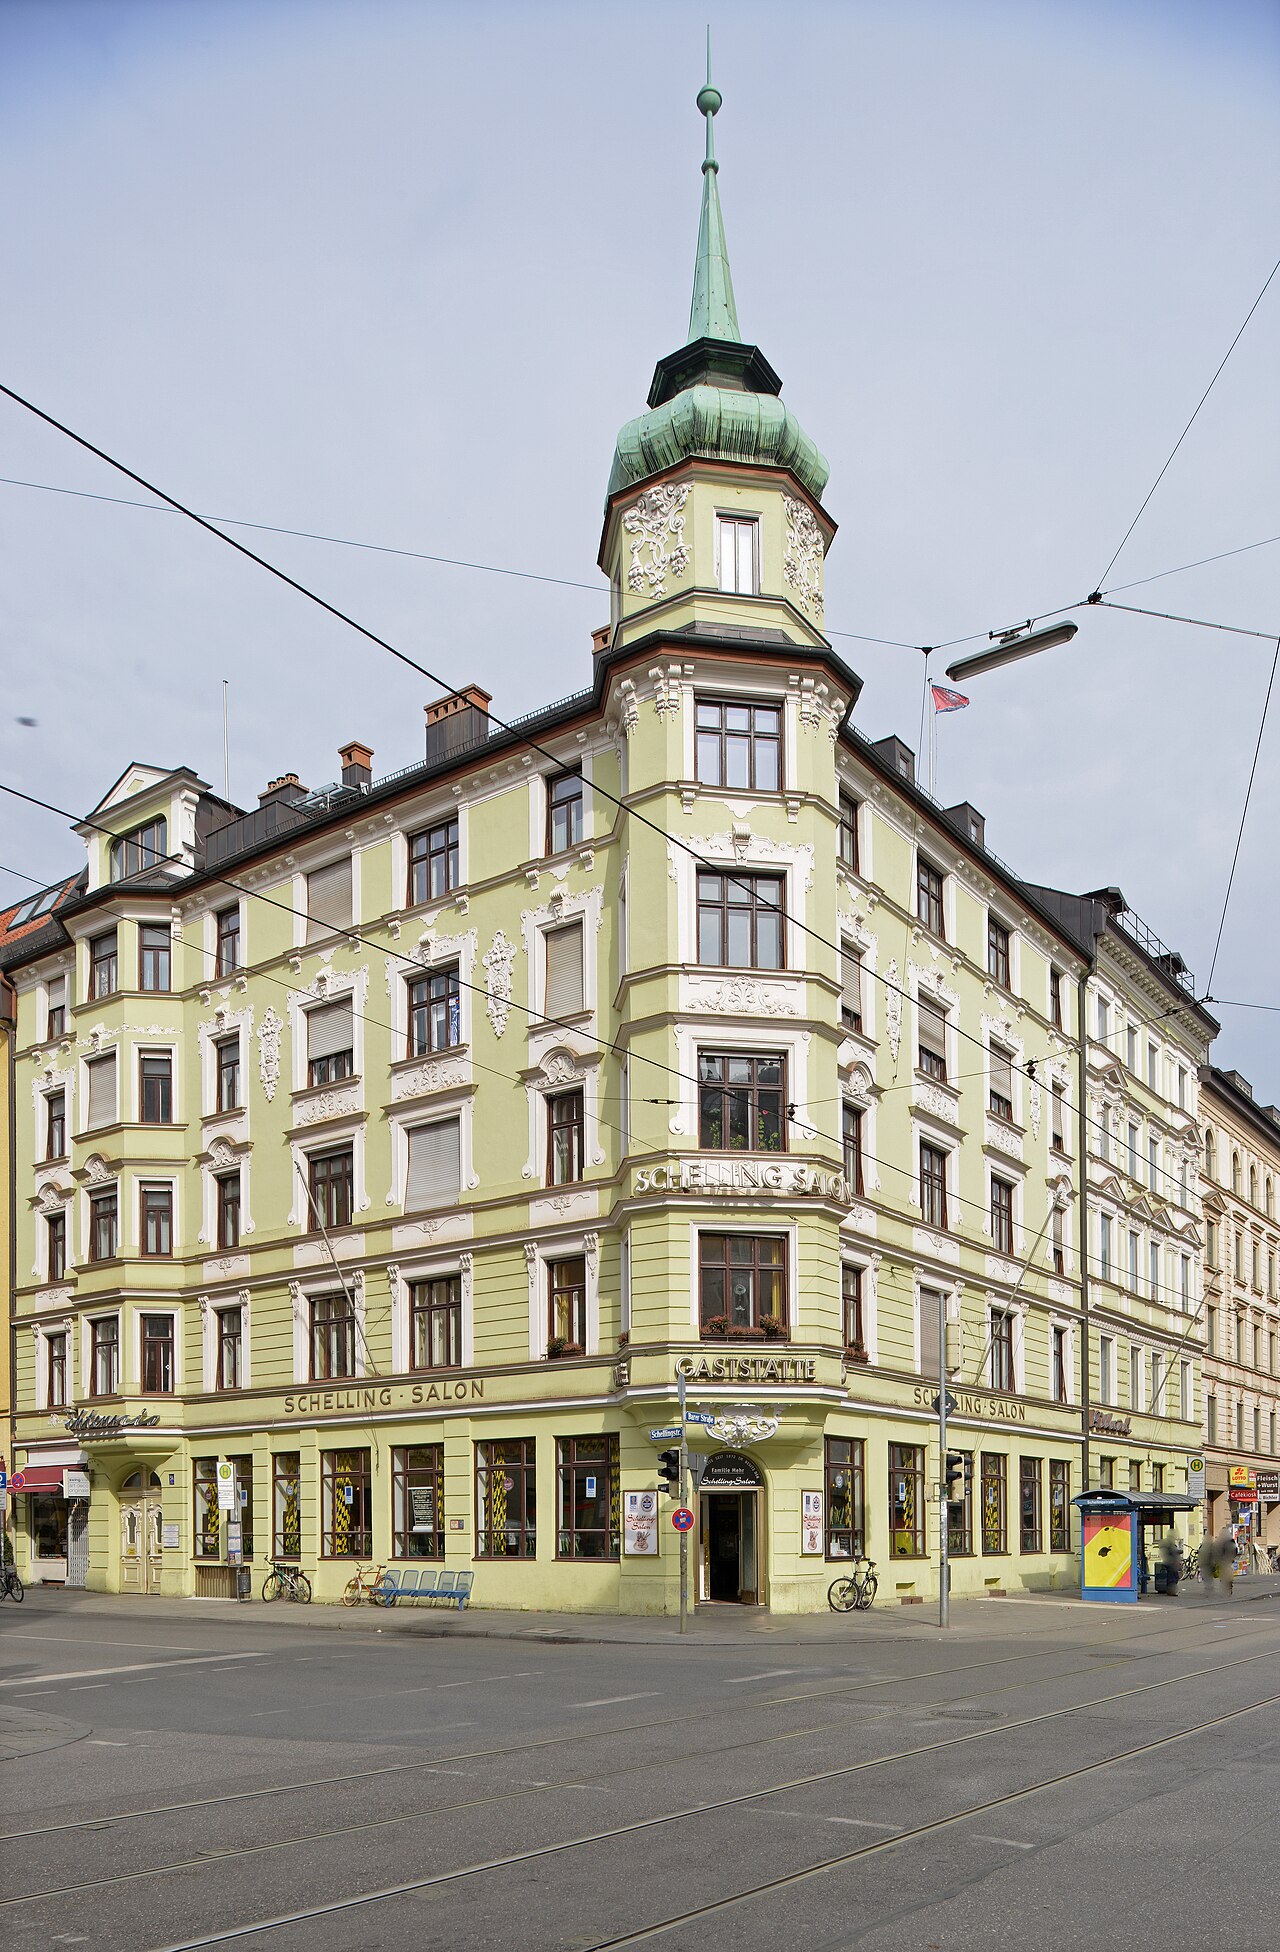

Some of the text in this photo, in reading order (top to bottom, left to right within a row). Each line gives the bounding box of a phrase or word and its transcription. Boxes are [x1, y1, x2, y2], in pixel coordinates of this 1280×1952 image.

[637, 1162, 851, 1204] SCHELLING SALON
[284, 1379, 484, 1413] SCHELLING SALON
[913, 1386, 1025, 1420] SCHLING SALON
